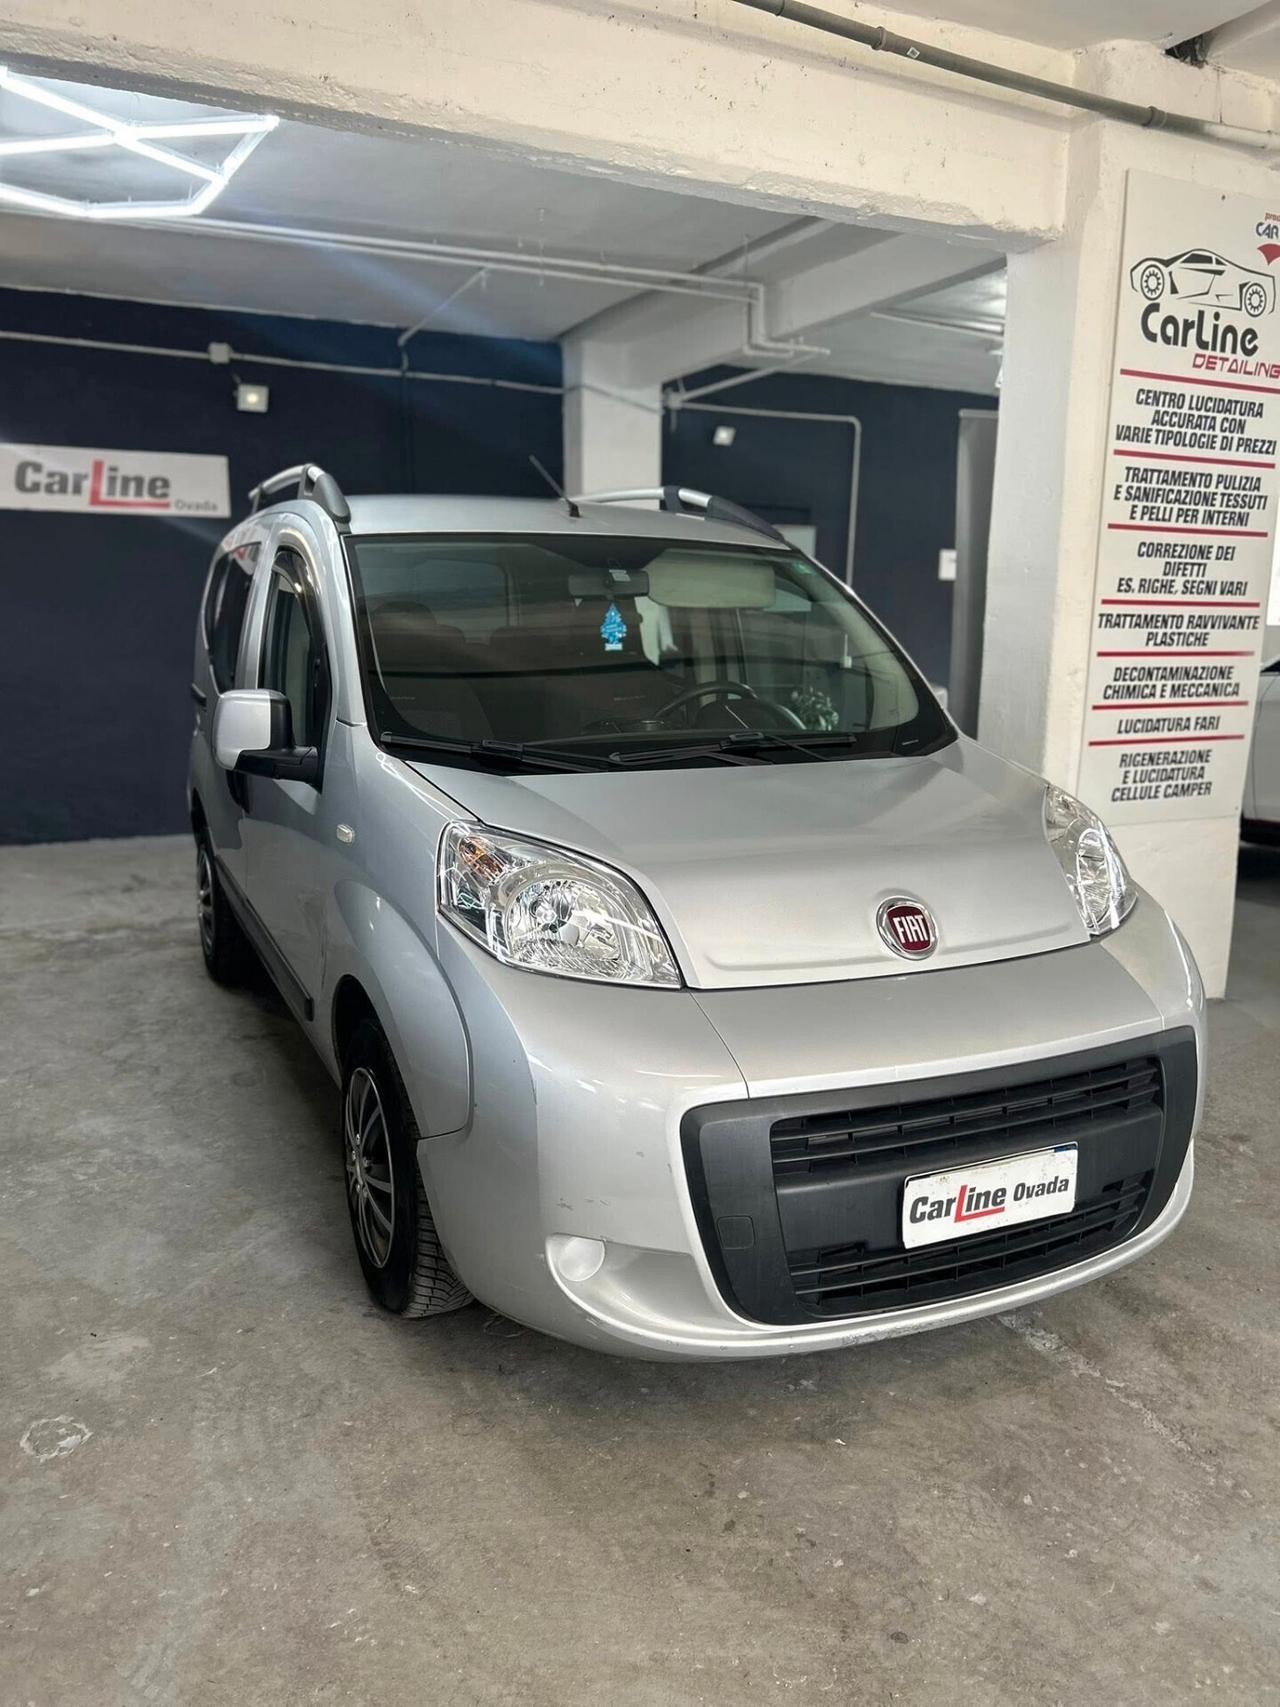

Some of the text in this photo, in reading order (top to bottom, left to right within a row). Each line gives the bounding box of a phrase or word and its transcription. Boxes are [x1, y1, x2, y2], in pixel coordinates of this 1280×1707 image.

[1141, 303, 1258, 356] CarLine
[1192, 353, 1280, 379] DETAILING
[1136, 389, 1264, 418] CENTRO LUCIDATURA
[1152, 410, 1246, 434] ACCURATA CON
[1115, 424, 1277, 455] VARIE TIPOLOGIE DI PREZZI
[15, 459, 171, 506] CarLine
[1125, 467, 1261, 492] TRATTAMENTO PULIZIA
[1114, 485, 1267, 510] E SANIFICAZIONE TESSUTI
[1129, 505, 1250, 526] E PELLI PER INTERNI
[1137, 542, 1236, 561] CORREZIONE DEI
[1162, 561, 1207, 577] DIFETTI
[1117, 578, 1248, 596] ES. RIGHE, SEGNI VARI
[1099, 614, 1260, 630] TRATTAMENTO RAVVIVANTE
[1145, 632, 1209, 646] PLASTICHE
[1113, 666, 1234, 682] DECONTAMINAZIONE
[1104, 683, 1240, 699] CHIMICA E MECCANICA
[1117, 716, 1220, 734] LUCIDATURA FARI
[1120, 750, 1212, 768] RIGENERAZIONE
[1122, 766, 1205, 784] E LUCIDATURA
[1111, 782, 1212, 802] CELLULE CAMPER
[893, 915, 928, 943] FIAT
[910, 1176, 1069, 1223] CarLine Ovada
